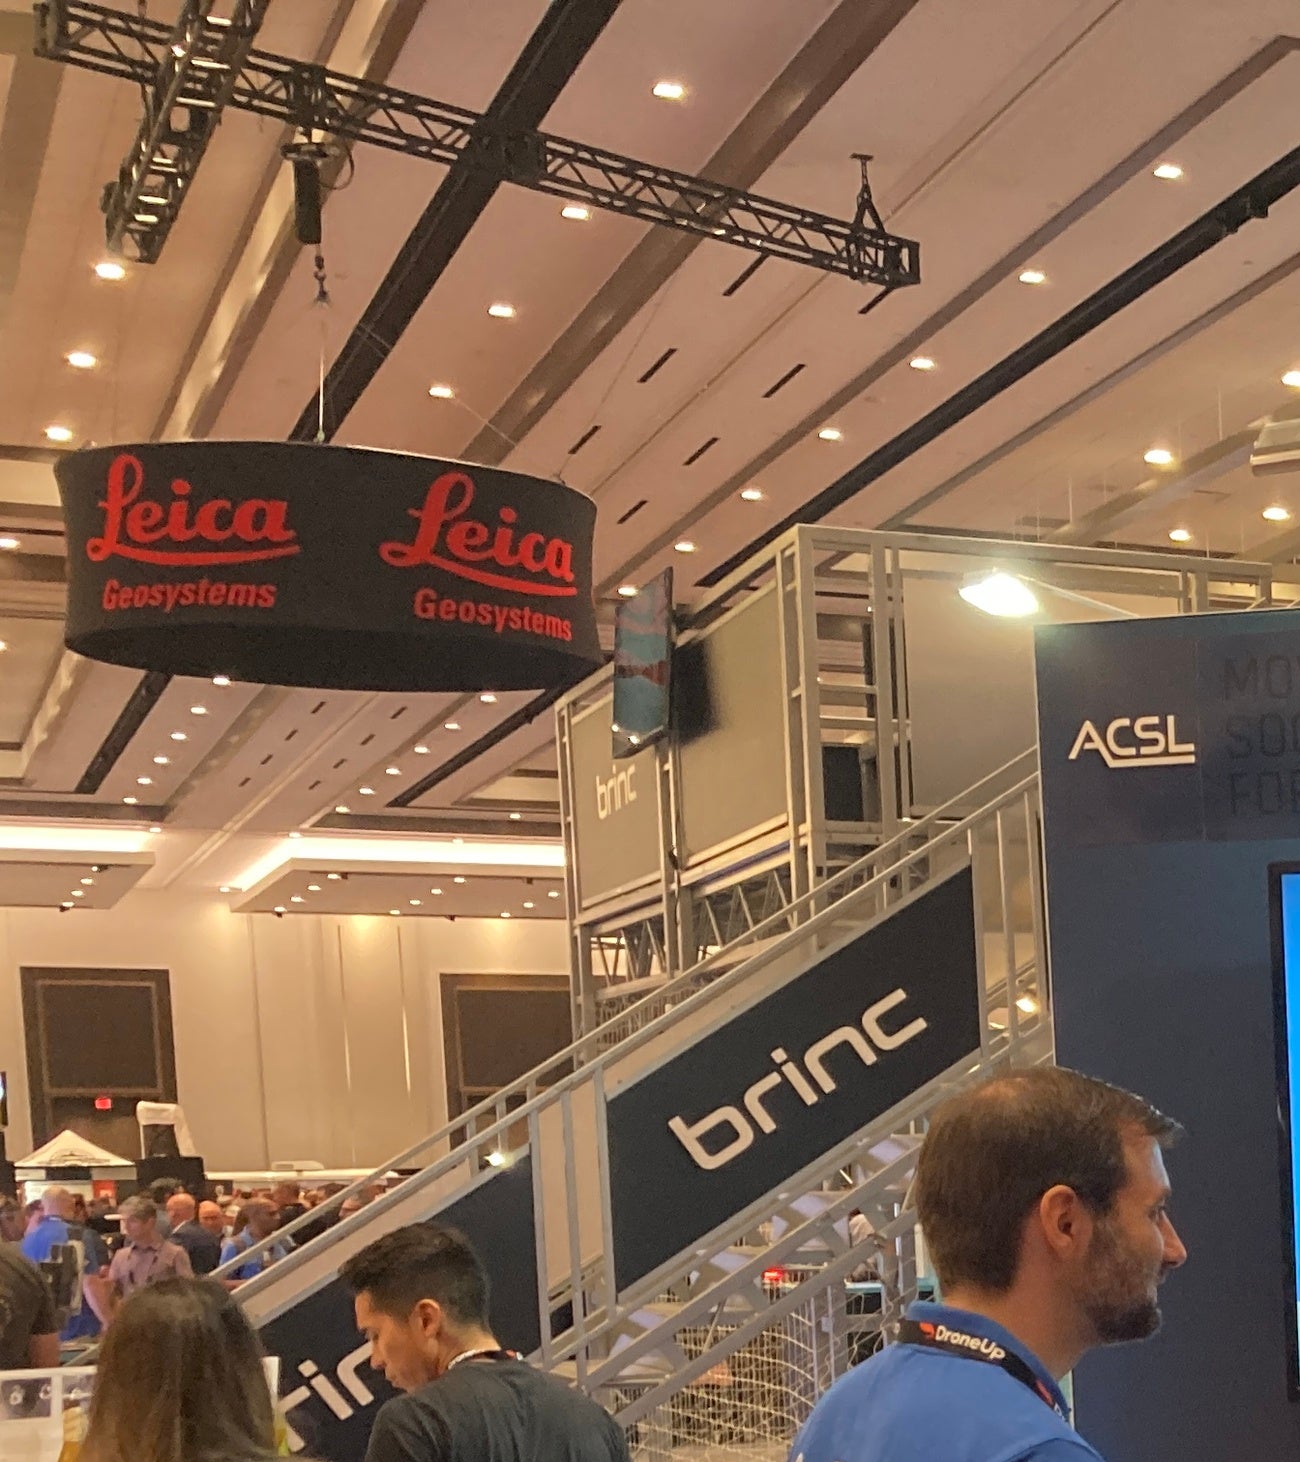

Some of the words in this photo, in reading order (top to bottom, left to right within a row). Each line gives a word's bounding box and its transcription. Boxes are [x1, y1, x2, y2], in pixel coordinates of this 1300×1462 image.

[87, 454, 300, 566] Leica
[379, 472, 577, 596] Leica
[103, 578, 276, 611] Geosystems
[413, 586, 573, 642] Geosystems
[1067, 714, 1196, 769] ACSL
[595, 762, 637, 820] brinc
[667, 987, 929, 1171] brinc
[934, 1325, 1006, 1361] DroneUp
